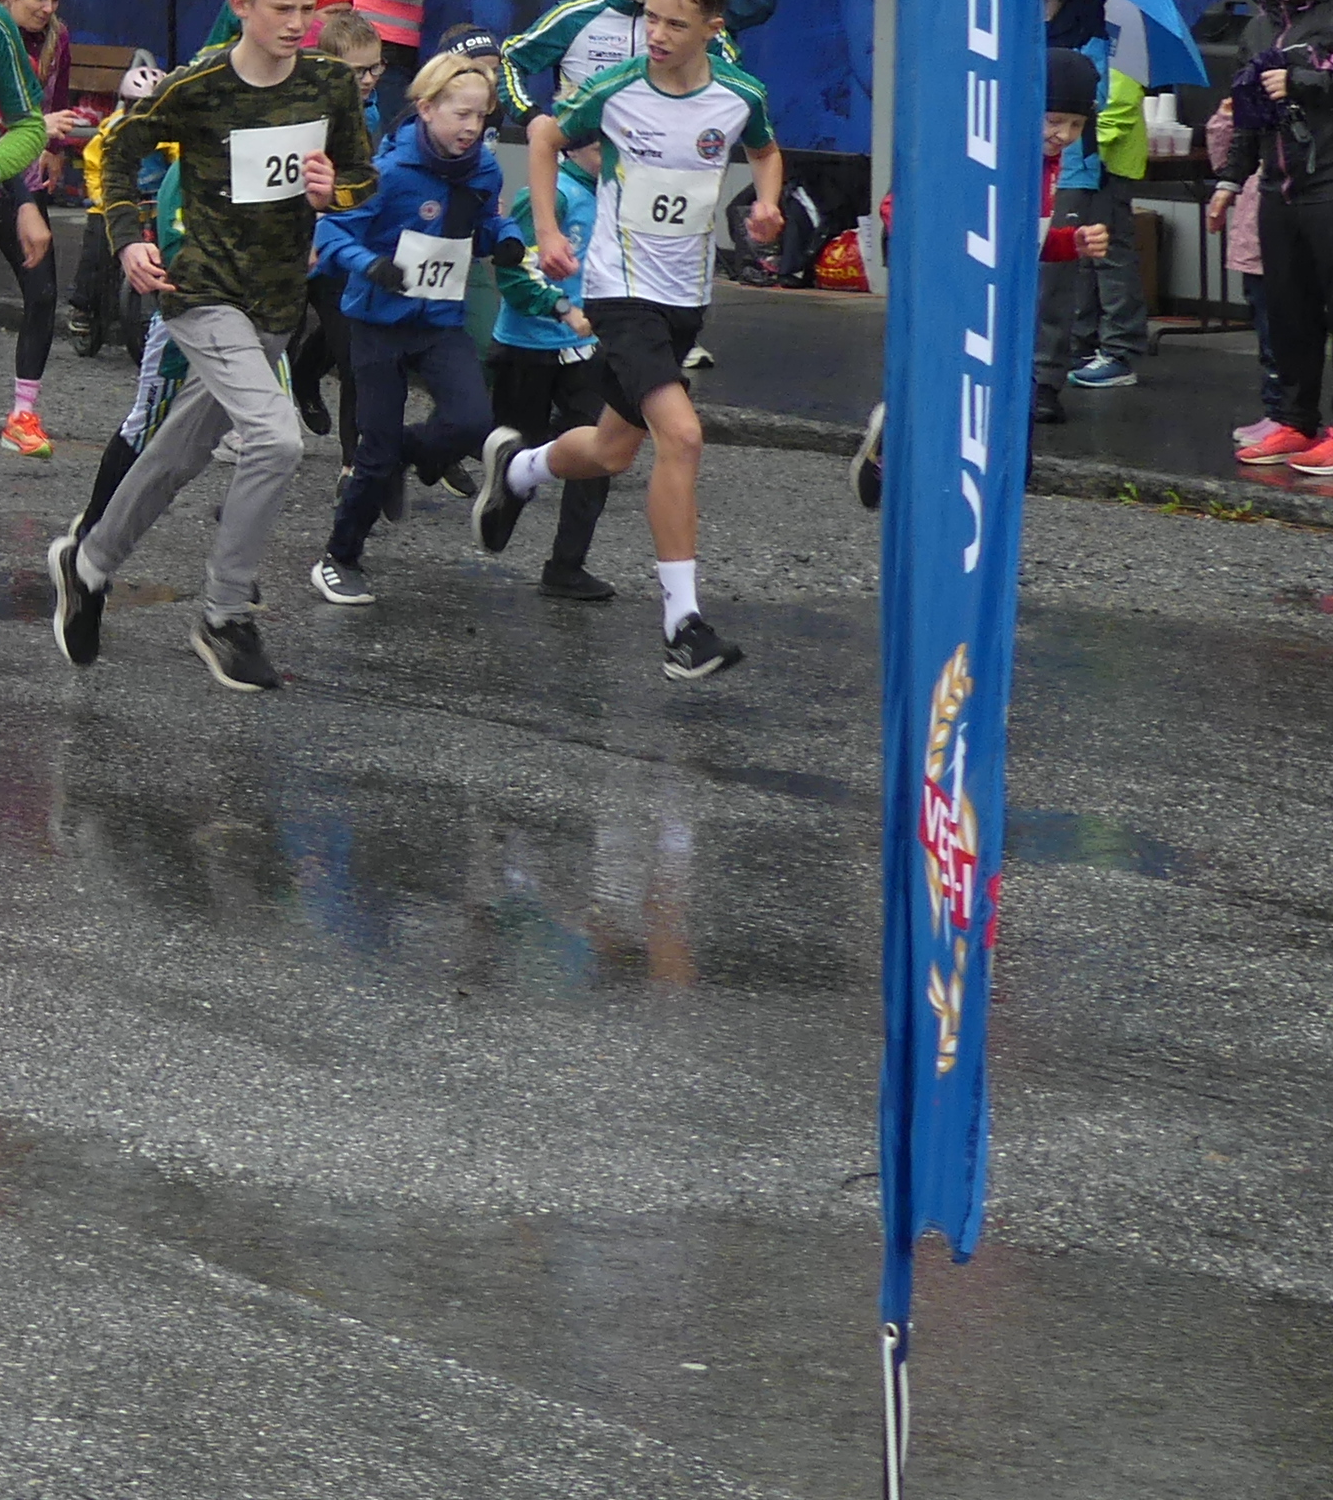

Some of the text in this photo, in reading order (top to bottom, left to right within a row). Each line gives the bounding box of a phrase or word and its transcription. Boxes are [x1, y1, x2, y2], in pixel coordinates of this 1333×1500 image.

[265, 152, 300, 188] 26
[652, 194, 688, 225] 62
[417, 259, 455, 288] 137
